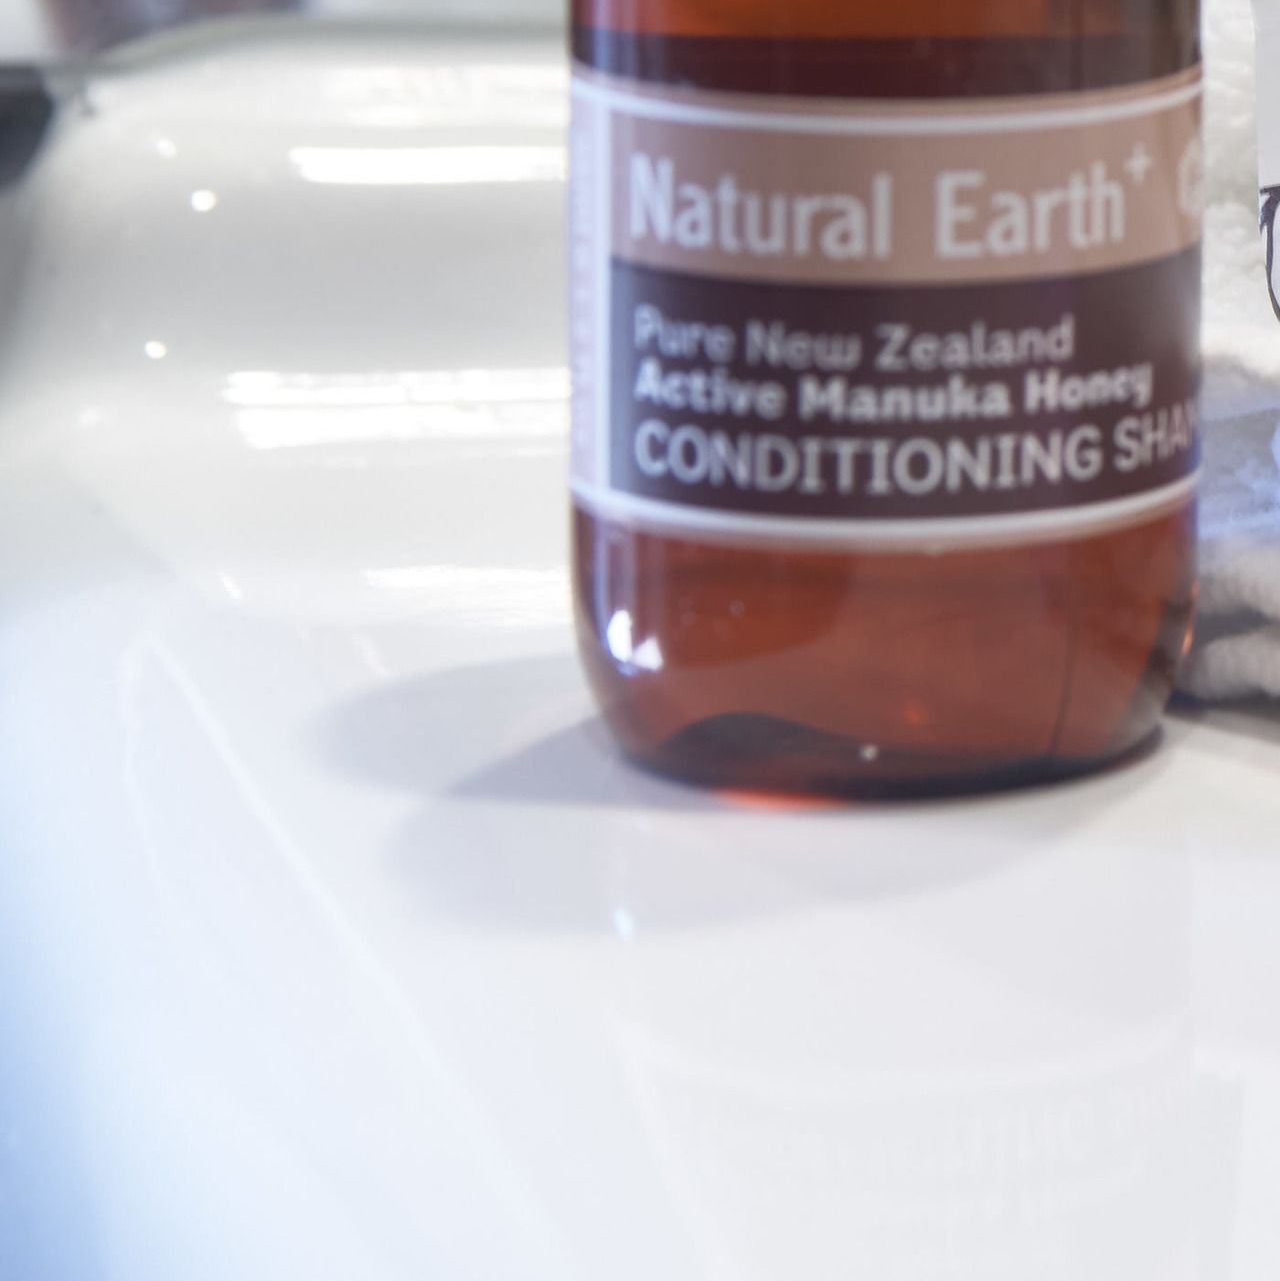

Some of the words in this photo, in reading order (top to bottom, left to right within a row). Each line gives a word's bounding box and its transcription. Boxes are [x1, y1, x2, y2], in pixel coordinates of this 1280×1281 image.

[627, 152, 895, 260] Natural
[633, 302, 736, 359] Pure
[745, 319, 861, 370] New
[875, 313, 1075, 372] Zealand
[633, 361, 787, 418] Active
[799, 371, 1011, 423] Manuka
[1023, 361, 1154, 413] Honey
[633, 417, 1104, 496] CONDITIONING
